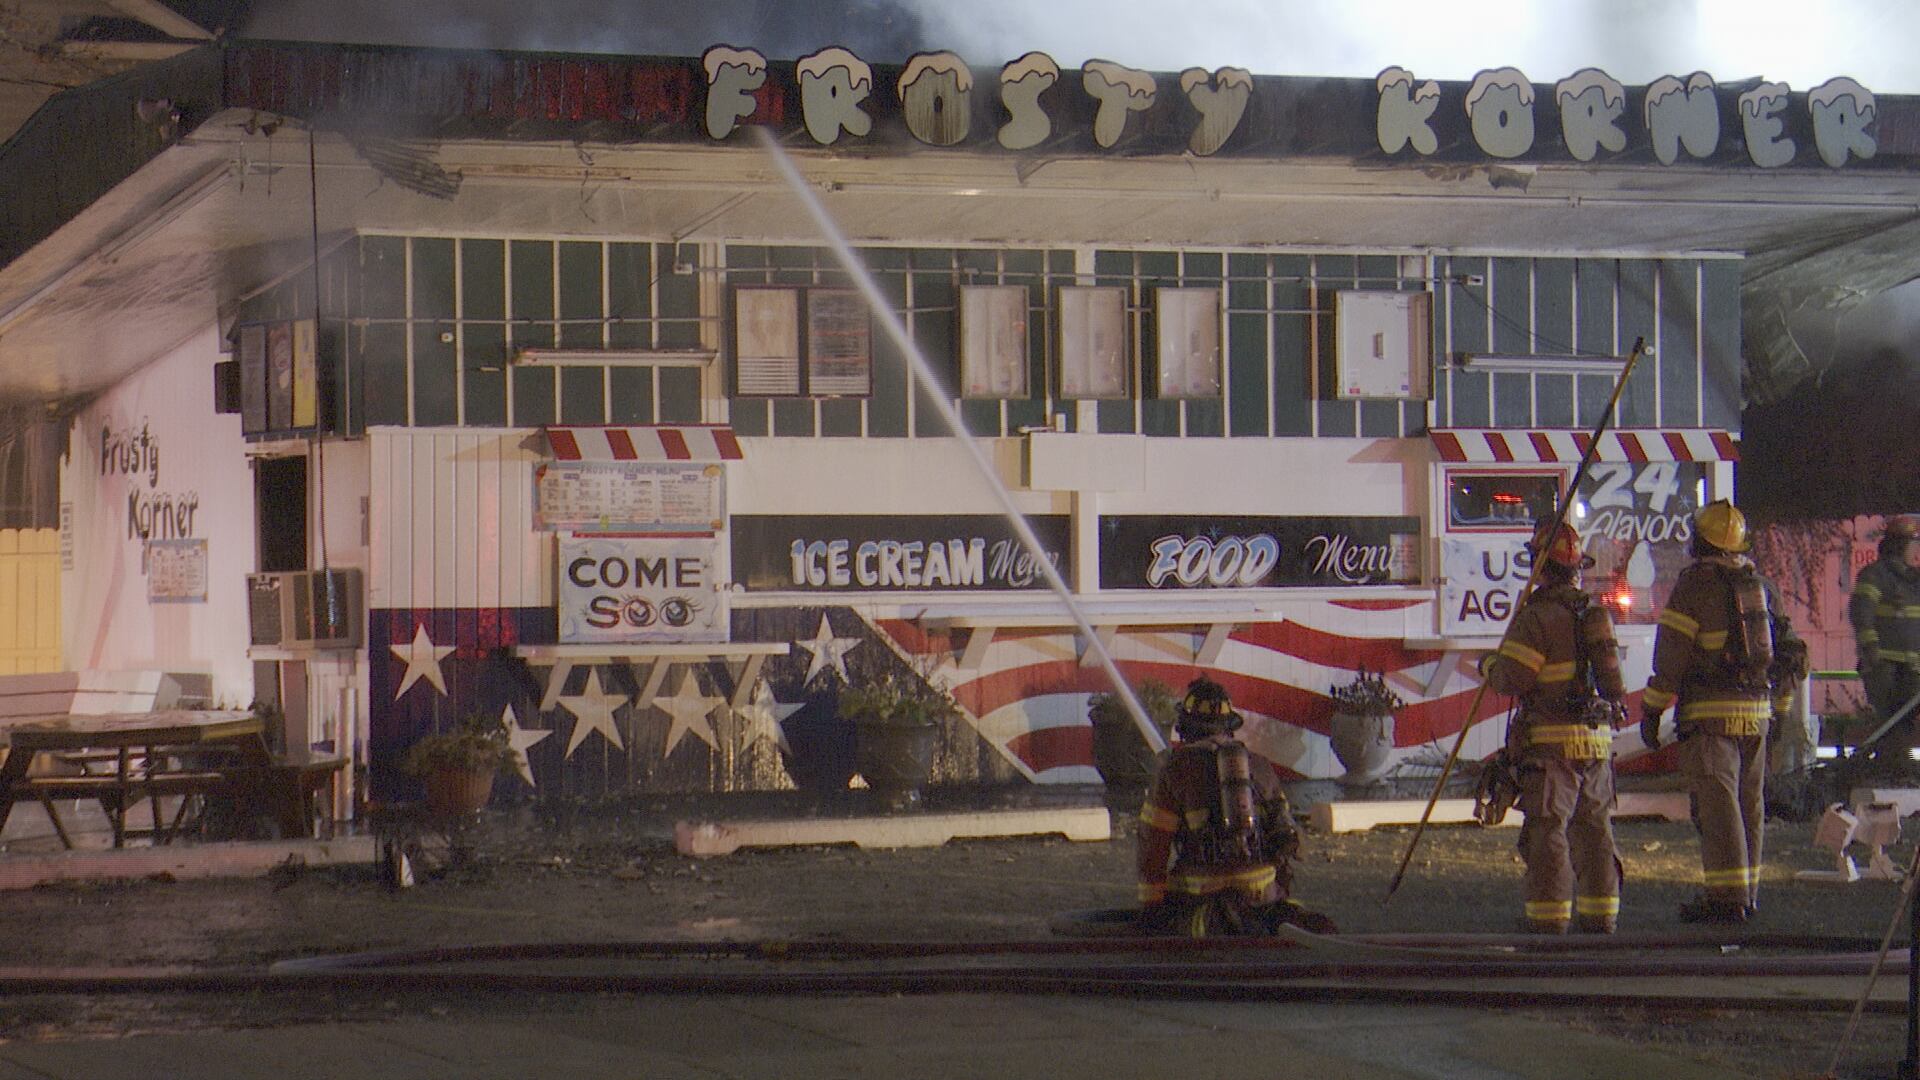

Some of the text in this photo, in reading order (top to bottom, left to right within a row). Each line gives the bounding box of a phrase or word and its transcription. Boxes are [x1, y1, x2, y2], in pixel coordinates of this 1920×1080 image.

[703, 45, 1877, 168] FROSTY KORNER
[1587, 462, 1680, 513] 24
[568, 557, 701, 589] COME
[791, 538, 850, 586] ICE
[856, 538, 986, 588] CREAM
[1147, 533, 1277, 588] FOOD
[1304, 534, 1396, 583] Menu
[1482, 550, 1531, 581] US
